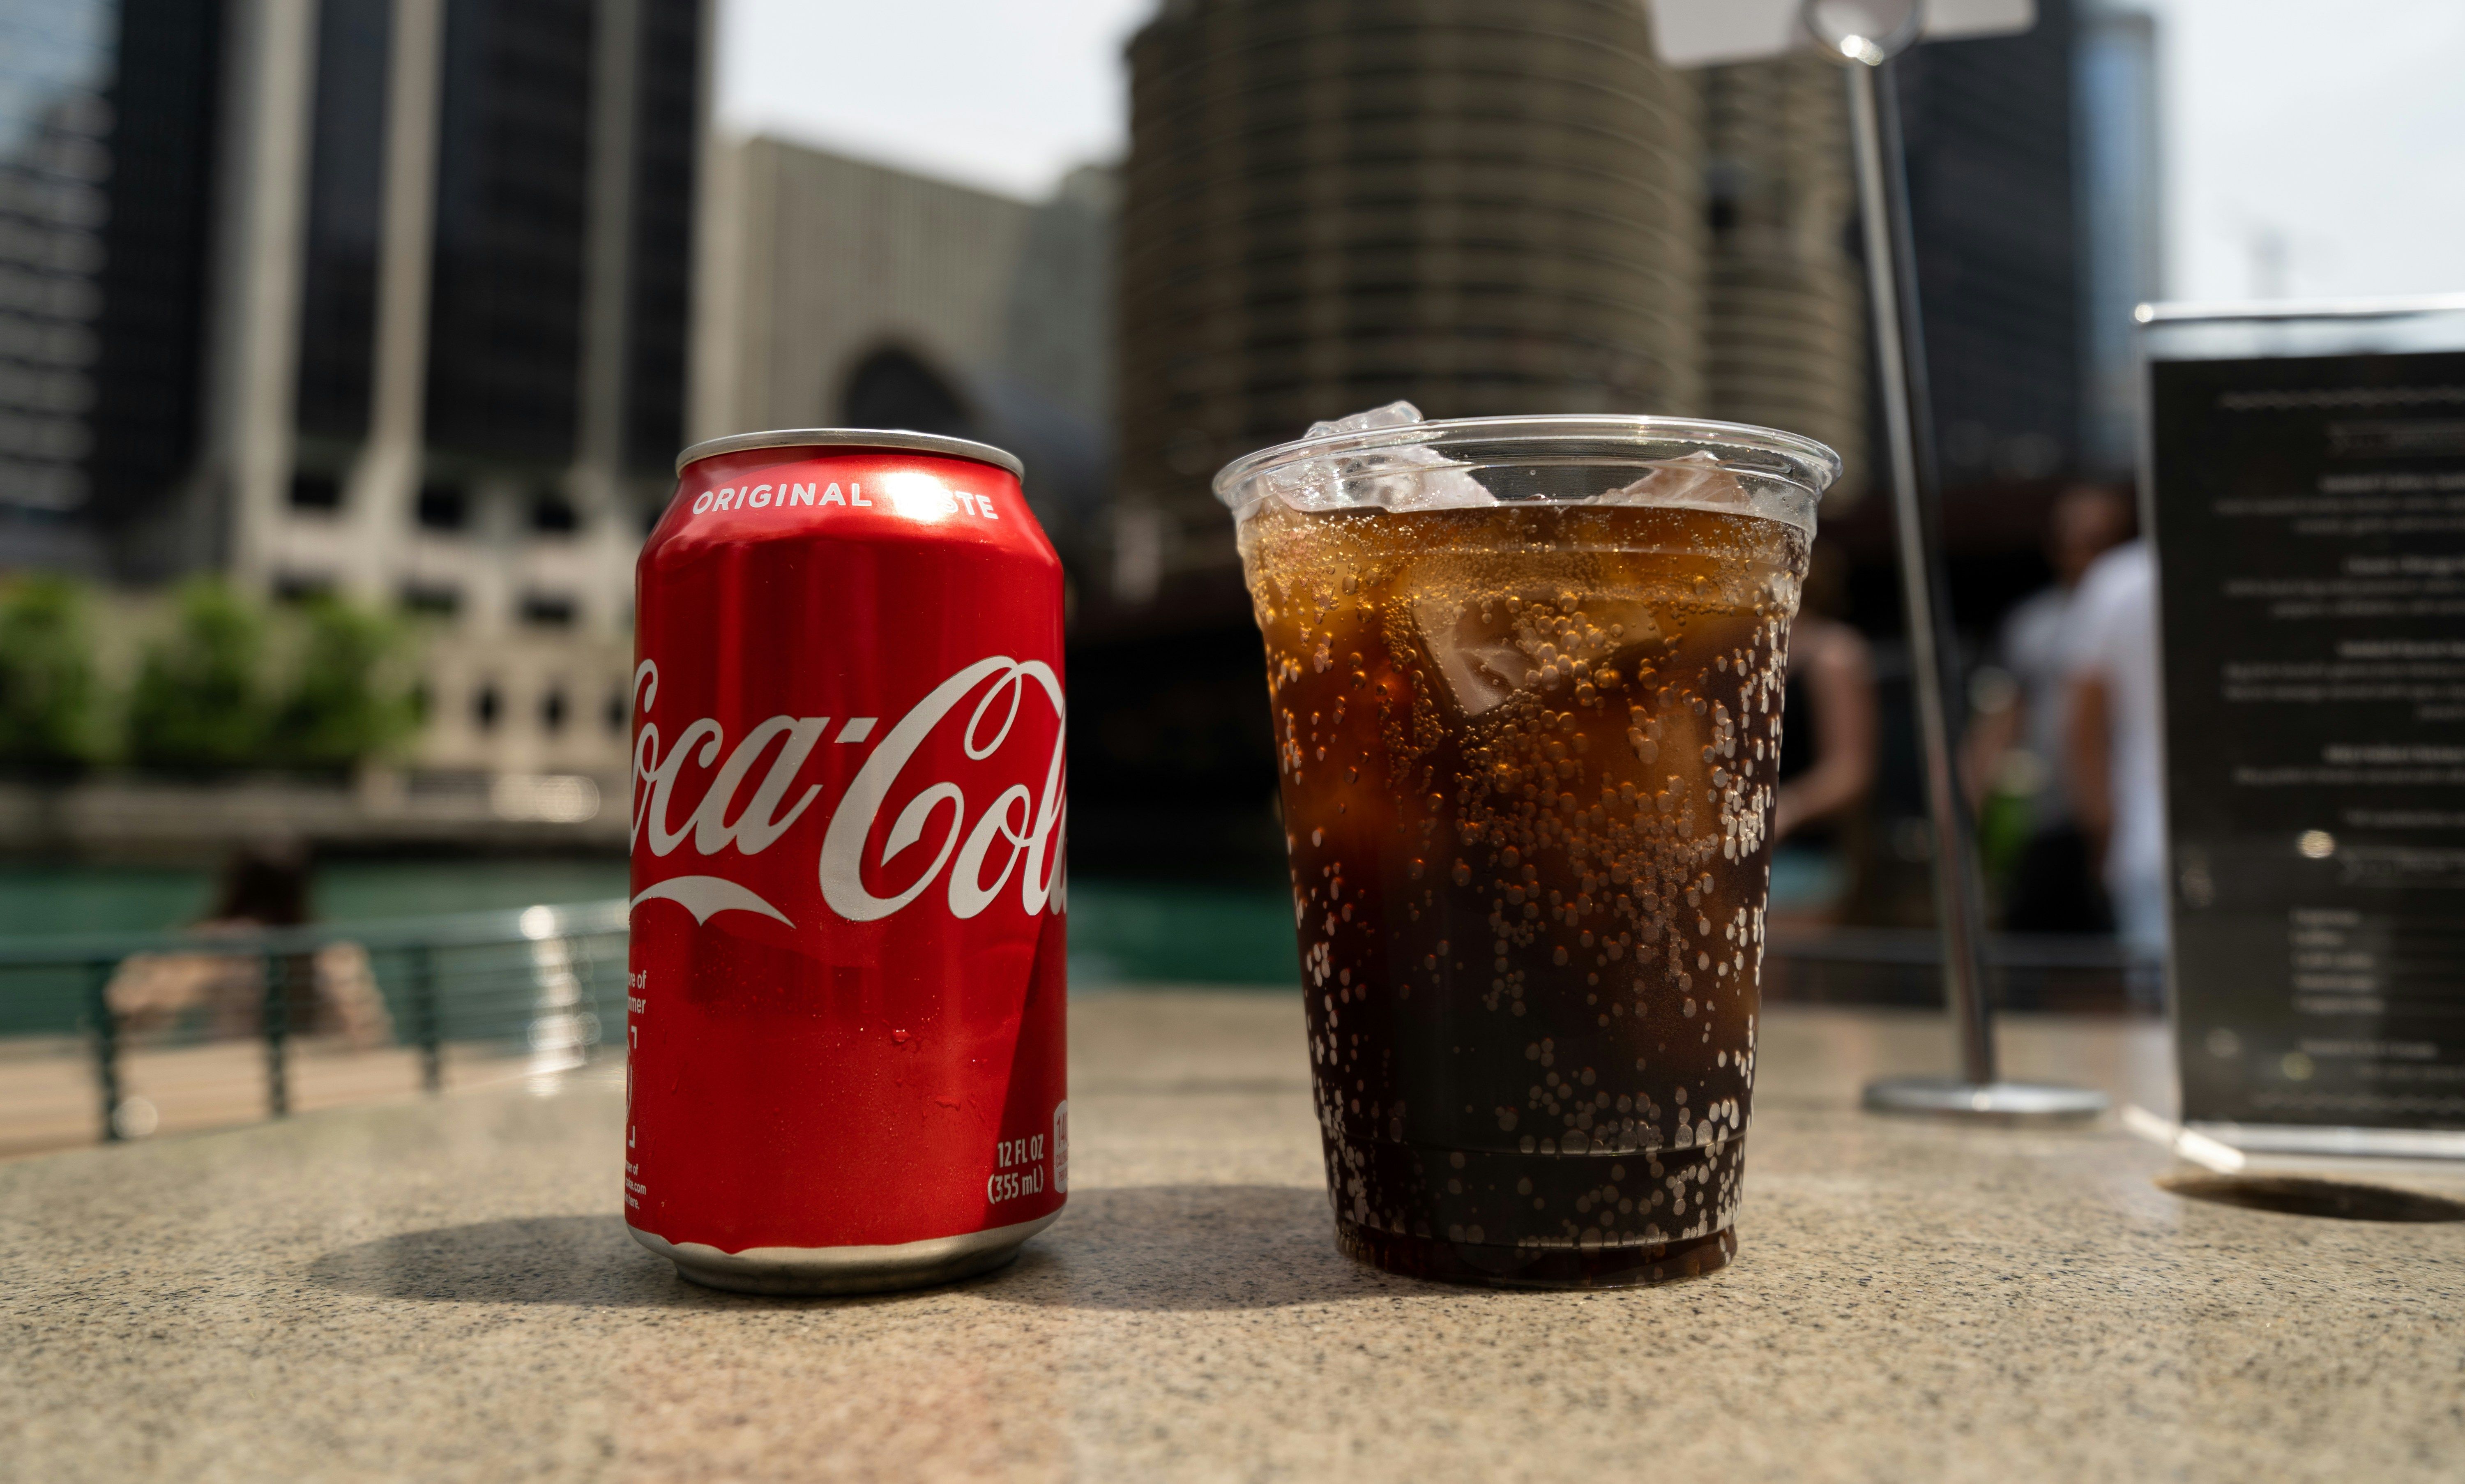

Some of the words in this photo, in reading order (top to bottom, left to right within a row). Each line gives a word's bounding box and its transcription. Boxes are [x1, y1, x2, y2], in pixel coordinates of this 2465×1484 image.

[692, 482, 872, 515] ORIGINAL
[896, 486, 999, 519] STE
[637, 970, 647, 989] of
[998, 1141, 1011, 1168] 12
[1015, 1138, 1027, 1164] FL
[1030, 1134, 1044, 1161] OZ
[633, 1164, 638, 1175] of
[988, 1173, 1019, 1205] (355
[1022, 1164, 1044, 1196] mL)
